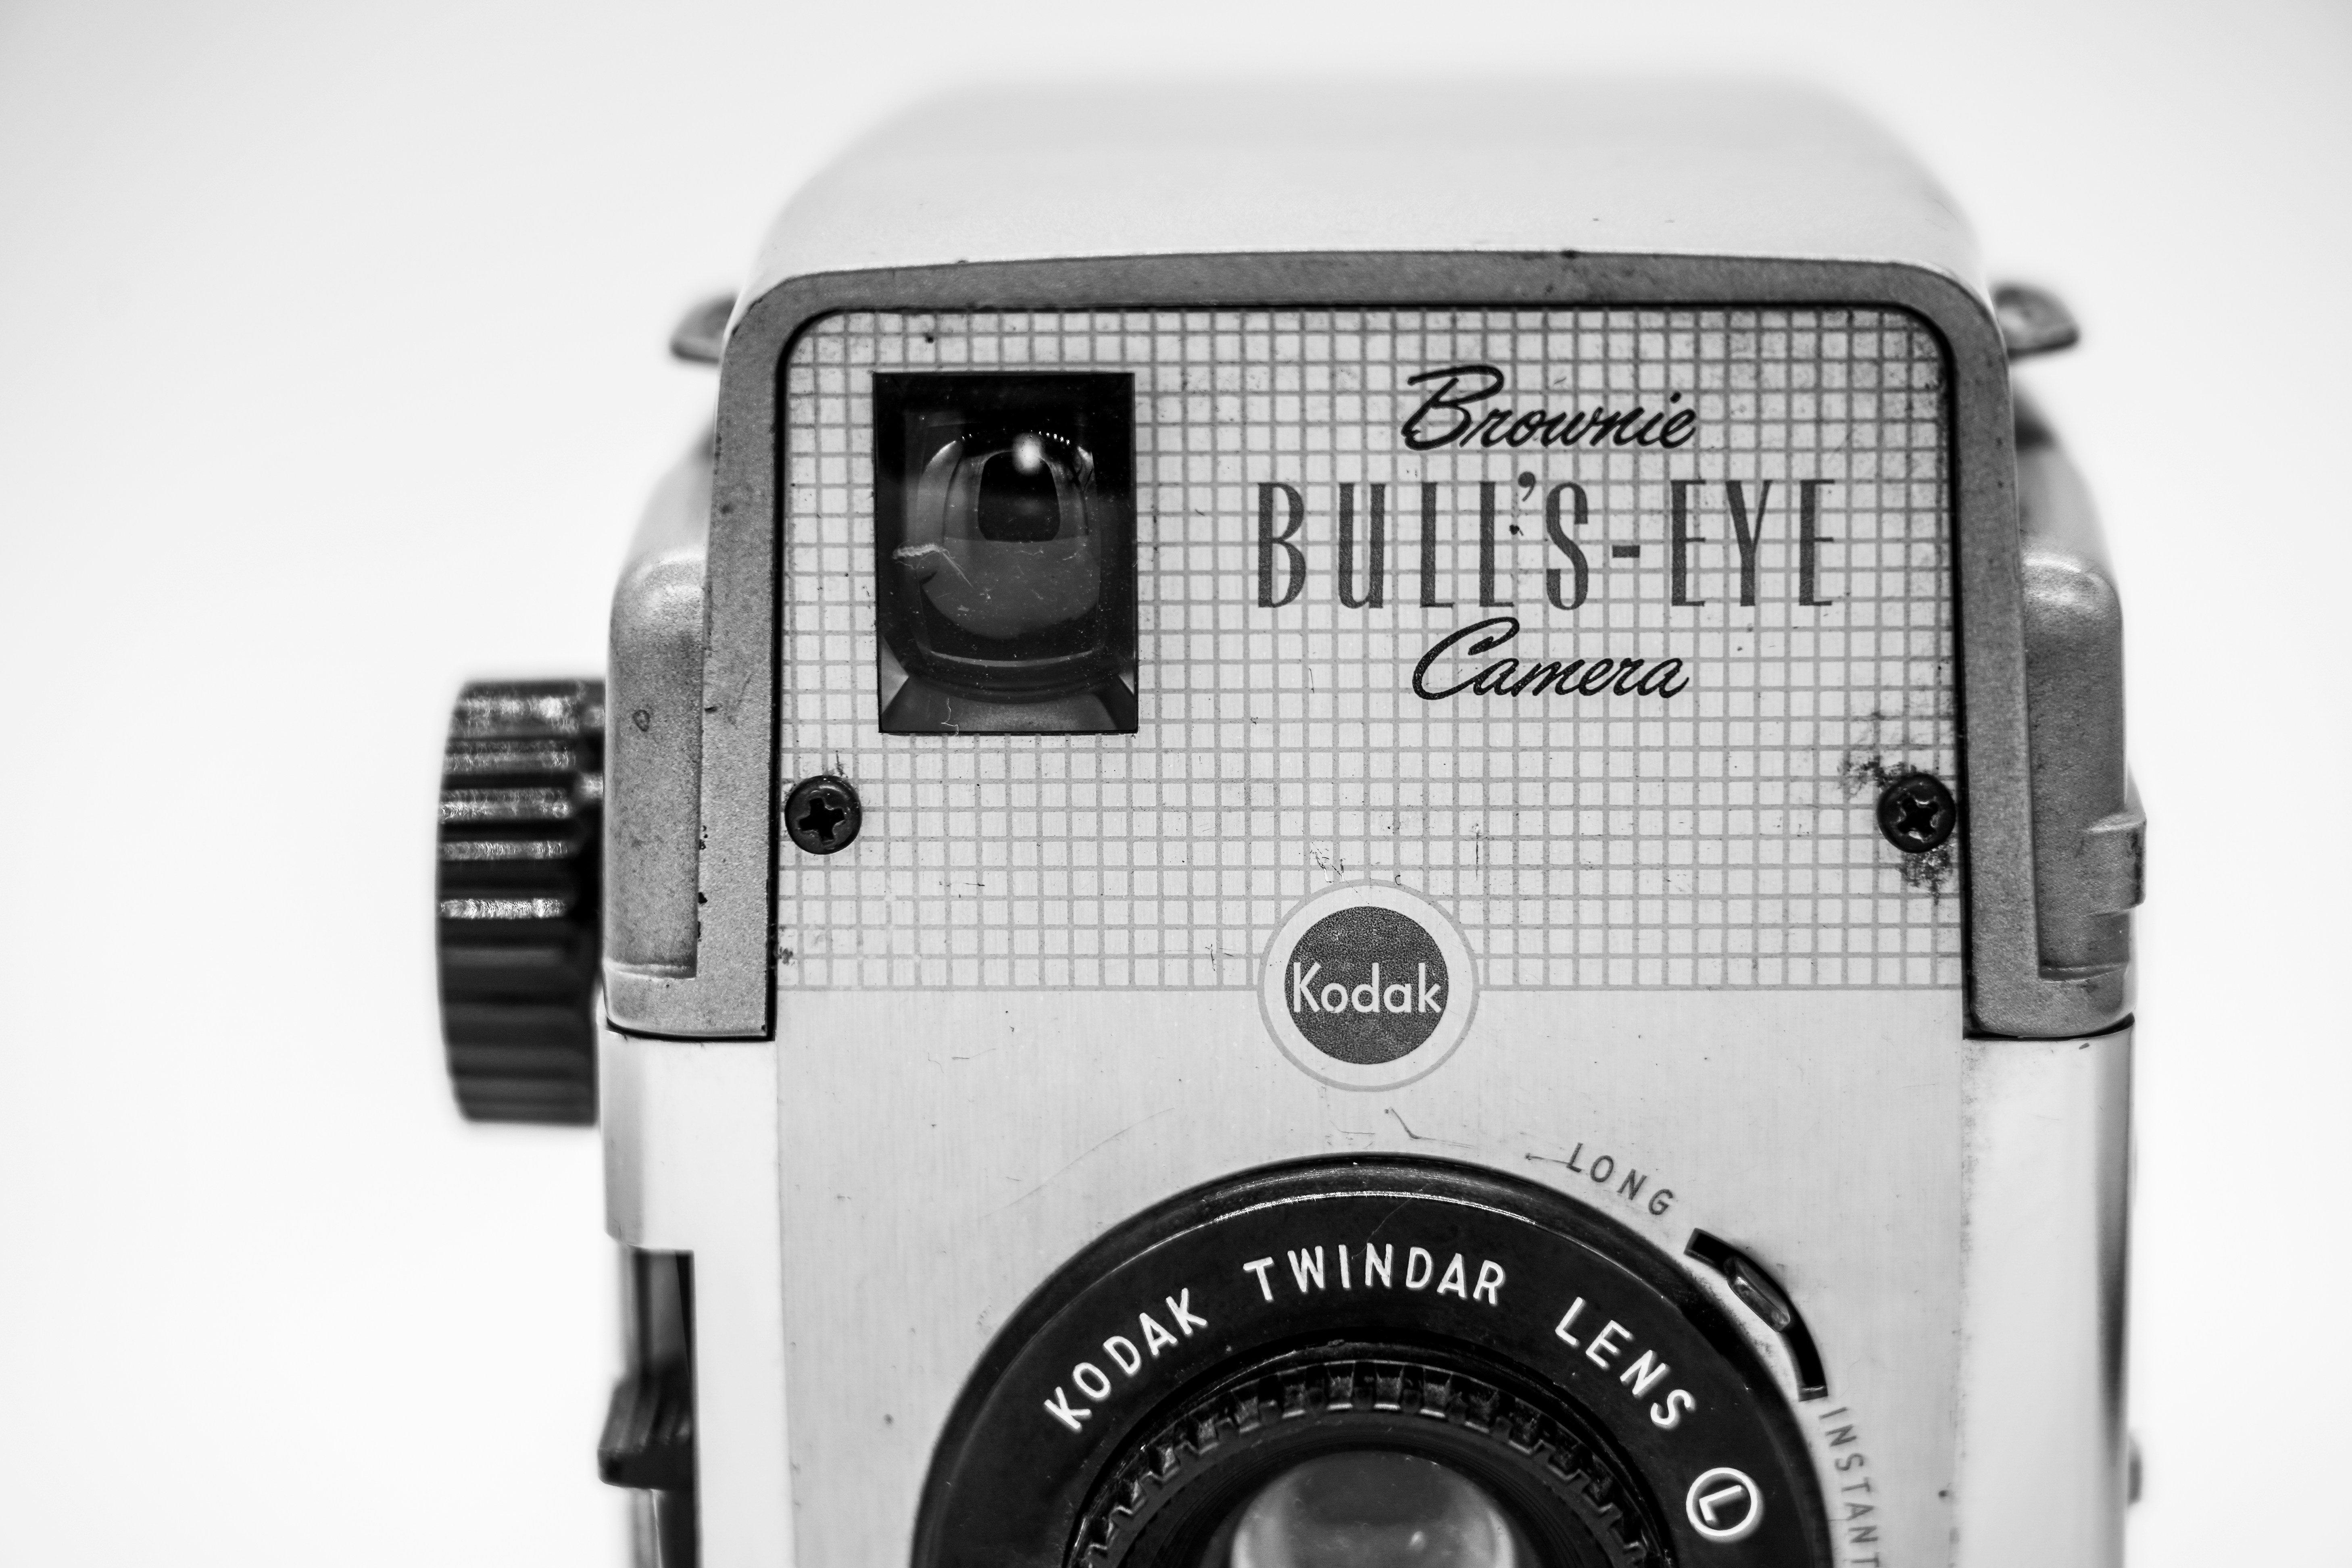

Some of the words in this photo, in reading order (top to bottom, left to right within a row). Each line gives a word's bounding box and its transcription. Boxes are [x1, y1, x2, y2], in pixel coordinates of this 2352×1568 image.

[1401, 364, 1696, 450] Brownie
[1257, 471, 1835, 610] BULL'S-EYE
[1412, 617, 1689, 701] Camera
[1293, 962, 1442, 1013] Kodak
[1566, 1143, 1674, 1216] LONG
[1043, 1288, 1208, 1430] KODAK
[1243, 1243, 1505, 1305] TWINDAR
[1555, 1297, 1695, 1429] LENS
[1819, 1406, 1880, 1568] INSTANT
